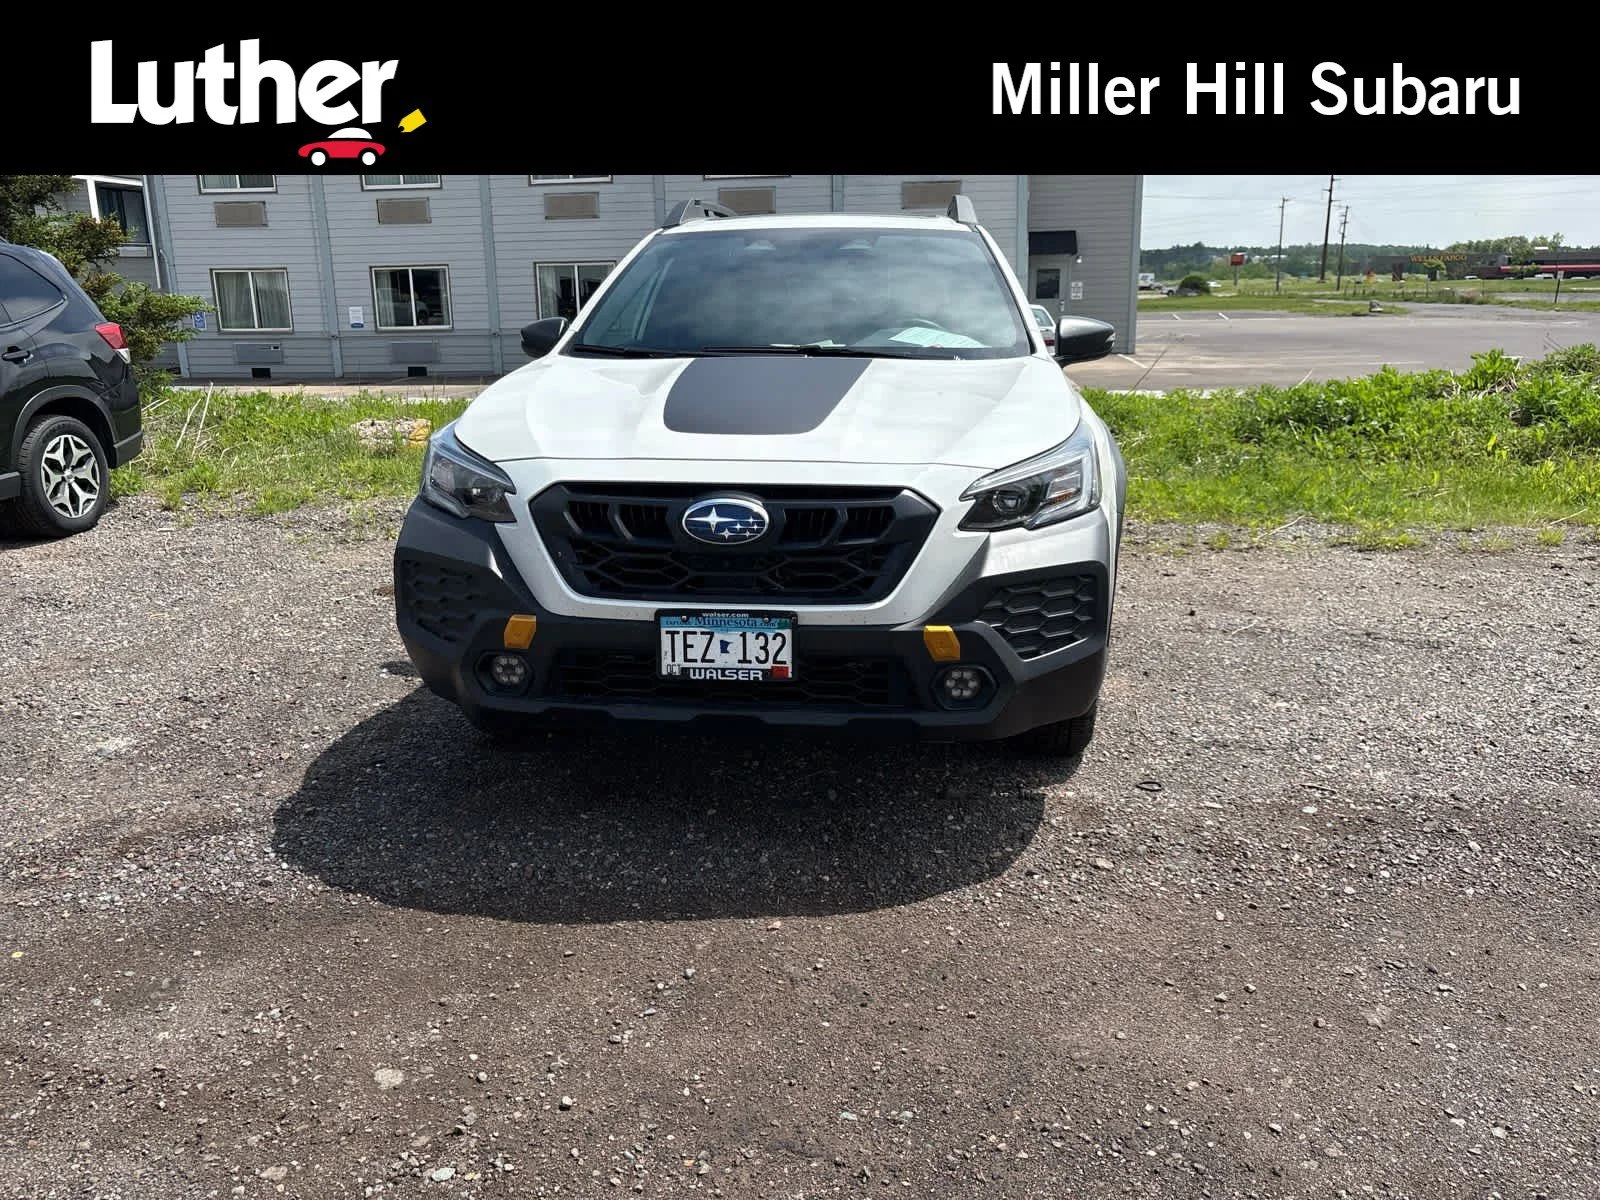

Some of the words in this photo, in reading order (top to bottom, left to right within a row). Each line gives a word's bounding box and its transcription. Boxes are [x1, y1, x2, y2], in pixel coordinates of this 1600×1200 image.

[665, 630, 716, 664] TEZ
[737, 631, 788, 665] 132
[689, 668, 763, 681] WALSER
